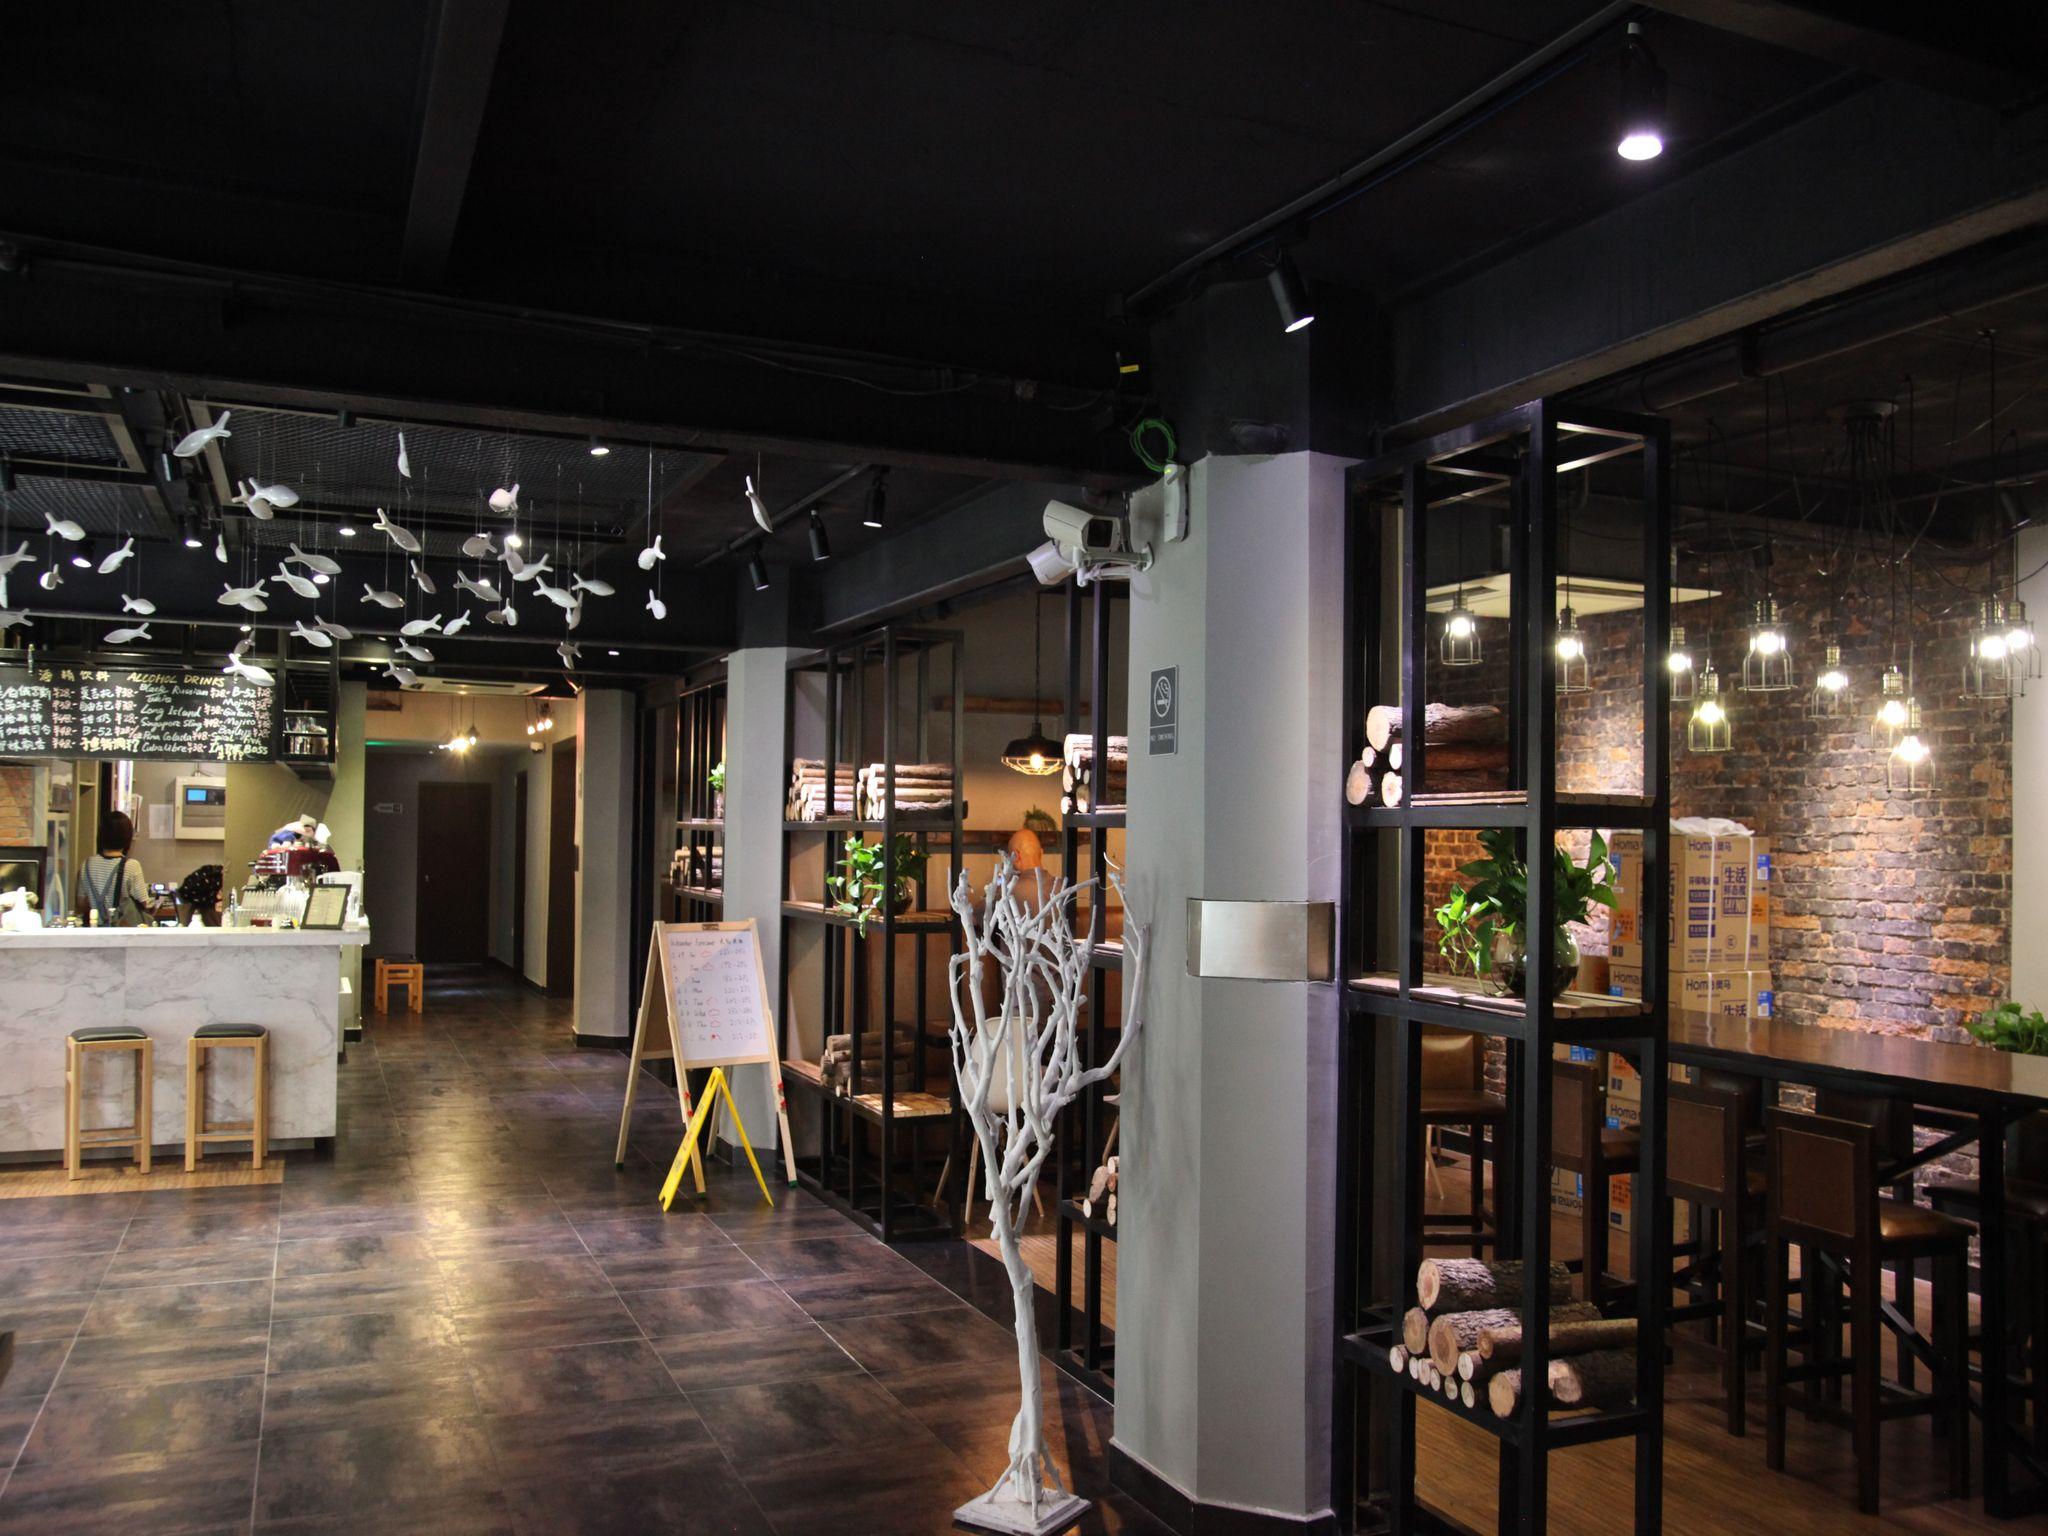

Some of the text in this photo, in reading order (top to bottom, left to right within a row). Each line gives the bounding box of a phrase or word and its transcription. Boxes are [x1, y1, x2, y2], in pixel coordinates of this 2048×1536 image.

[184, 675, 225, 687] DRINKS
[140, 704, 164, 720] Long
[168, 705, 201, 718] Island
[1724, 867, 1747, 883] 生活
[1723, 1004, 1747, 1017] 生活
[1611, 1104, 1637, 1120] Homa
